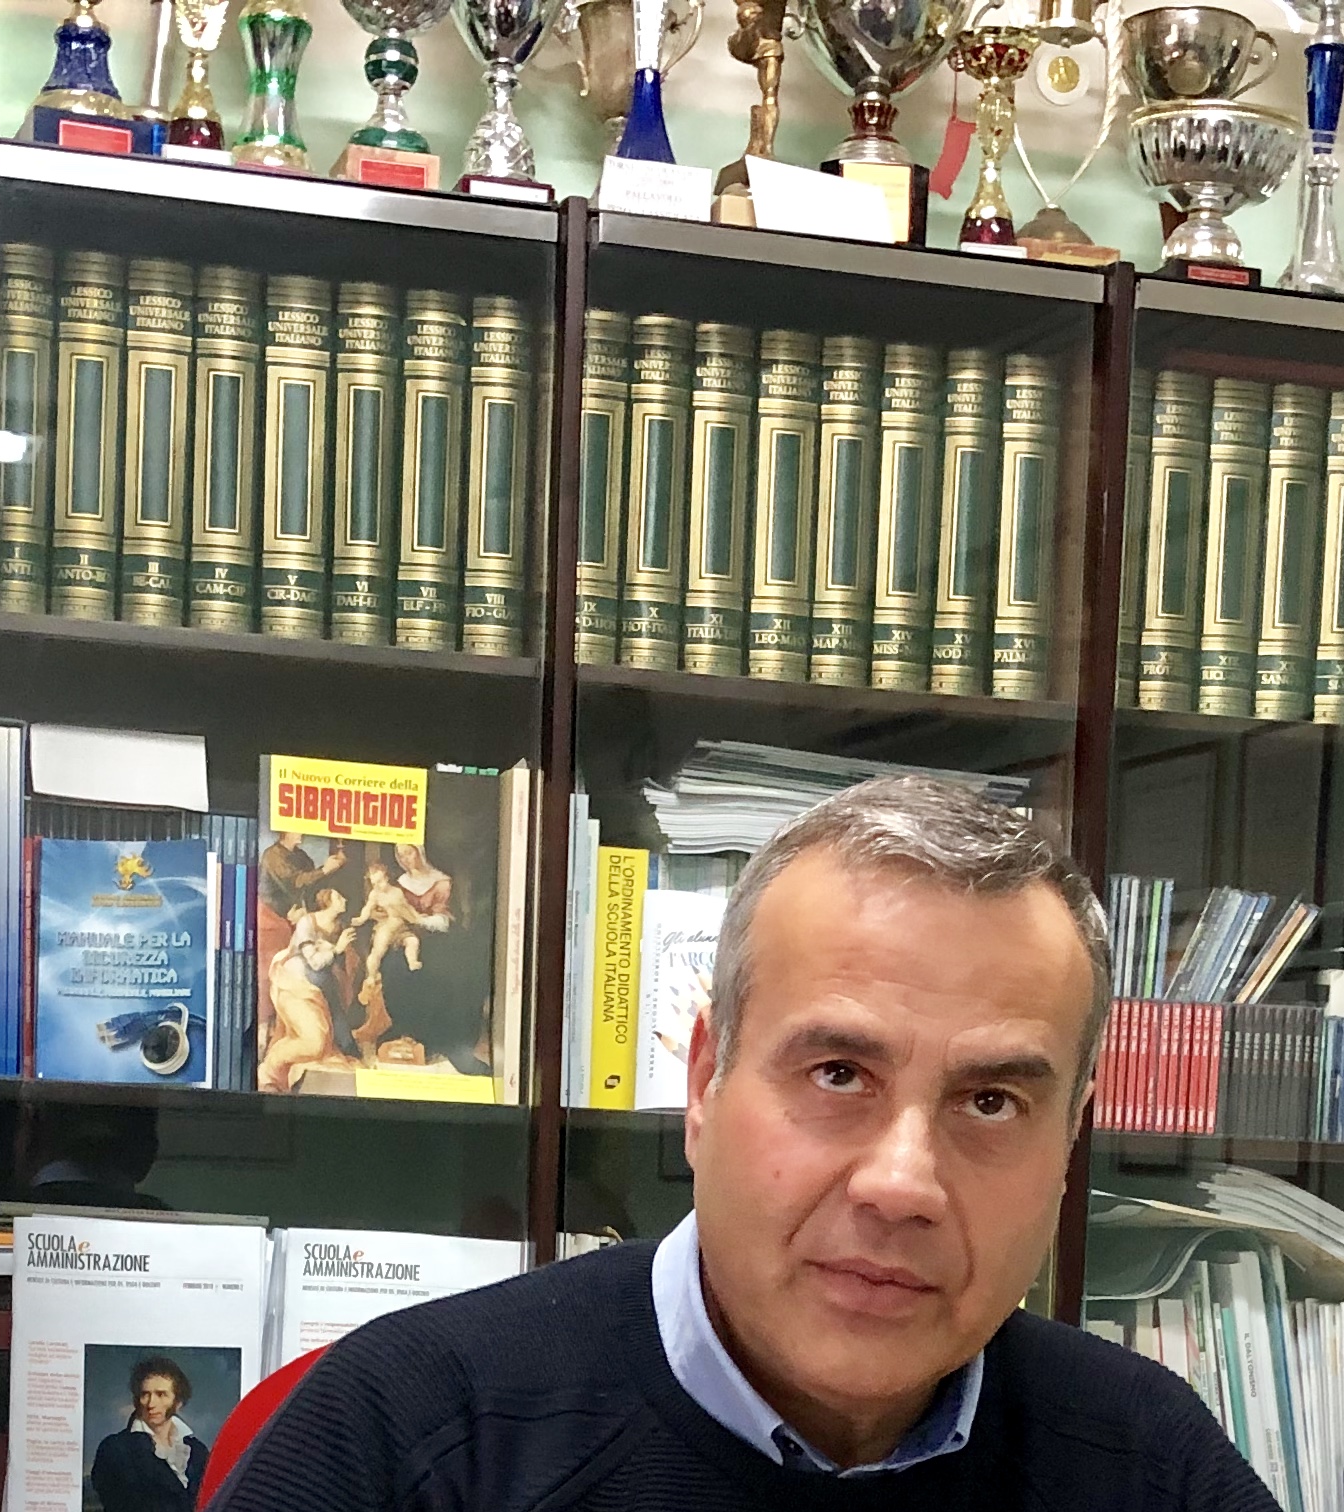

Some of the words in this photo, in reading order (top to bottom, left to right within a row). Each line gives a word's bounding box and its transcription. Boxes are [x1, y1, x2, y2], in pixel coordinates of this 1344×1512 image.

[71, 286, 113, 299] LESSICO
[60, 297, 123, 312] UNIVERSALE
[139, 295, 182, 309] LESSICO
[208, 302, 248, 316] LESSICO
[68, 308, 115, 322] ITALIANO
[129, 305, 191, 321] UNIVERSALE
[278, 310, 319, 324] LESSICO
[136, 317, 184, 331] ITALIANO
[205, 324, 252, 337] ITALIANO
[268, 321, 328, 337] UNIVERSALE
[348, 317, 388, 330] LESSICO
[275, 332, 323, 346] ITALIANO
[147, 561, 160, 574] III
[215, 567, 228, 580] IV
[287, 575, 298, 586] V
[356, 581, 369, 593] VI
[420, 586, 438, 598] VII
[485, 593, 506, 605] VIII
[649, 606, 659, 618] X
[709, 613, 723, 625] XI
[772, 618, 791, 630] XII
[279, 768, 287, 780] Il
[291, 769, 331, 785] Nuovo
[334, 773, 386, 790] Corriere
[389, 777, 419, 793] della
[608, 854, 621, 899] DELLA
[618, 855, 635, 969] L'ORDINAMENTO
[605, 901, 620, 959] SCUOLA
[57, 931, 135, 948] MANUALE
[138, 932, 168, 948] PER
[171, 931, 192, 948] LA
[82, 950, 169, 968] SICUREZZA
[70, 968, 179, 986] INFORMATICA
[602, 963, 617, 1023] ITALIANA
[615, 973, 629, 1045] DIDATTICO
[27, 1233, 77, 1253] SCUOLA
[78, 1240, 91, 1253] e
[304, 1243, 352, 1262] SCUOLA
[352, 1249, 365, 1263] e
[27, 1251, 151, 1273] AMMINISTRAZIONE
[303, 1260, 421, 1282] AMMINISTRAZIONE
